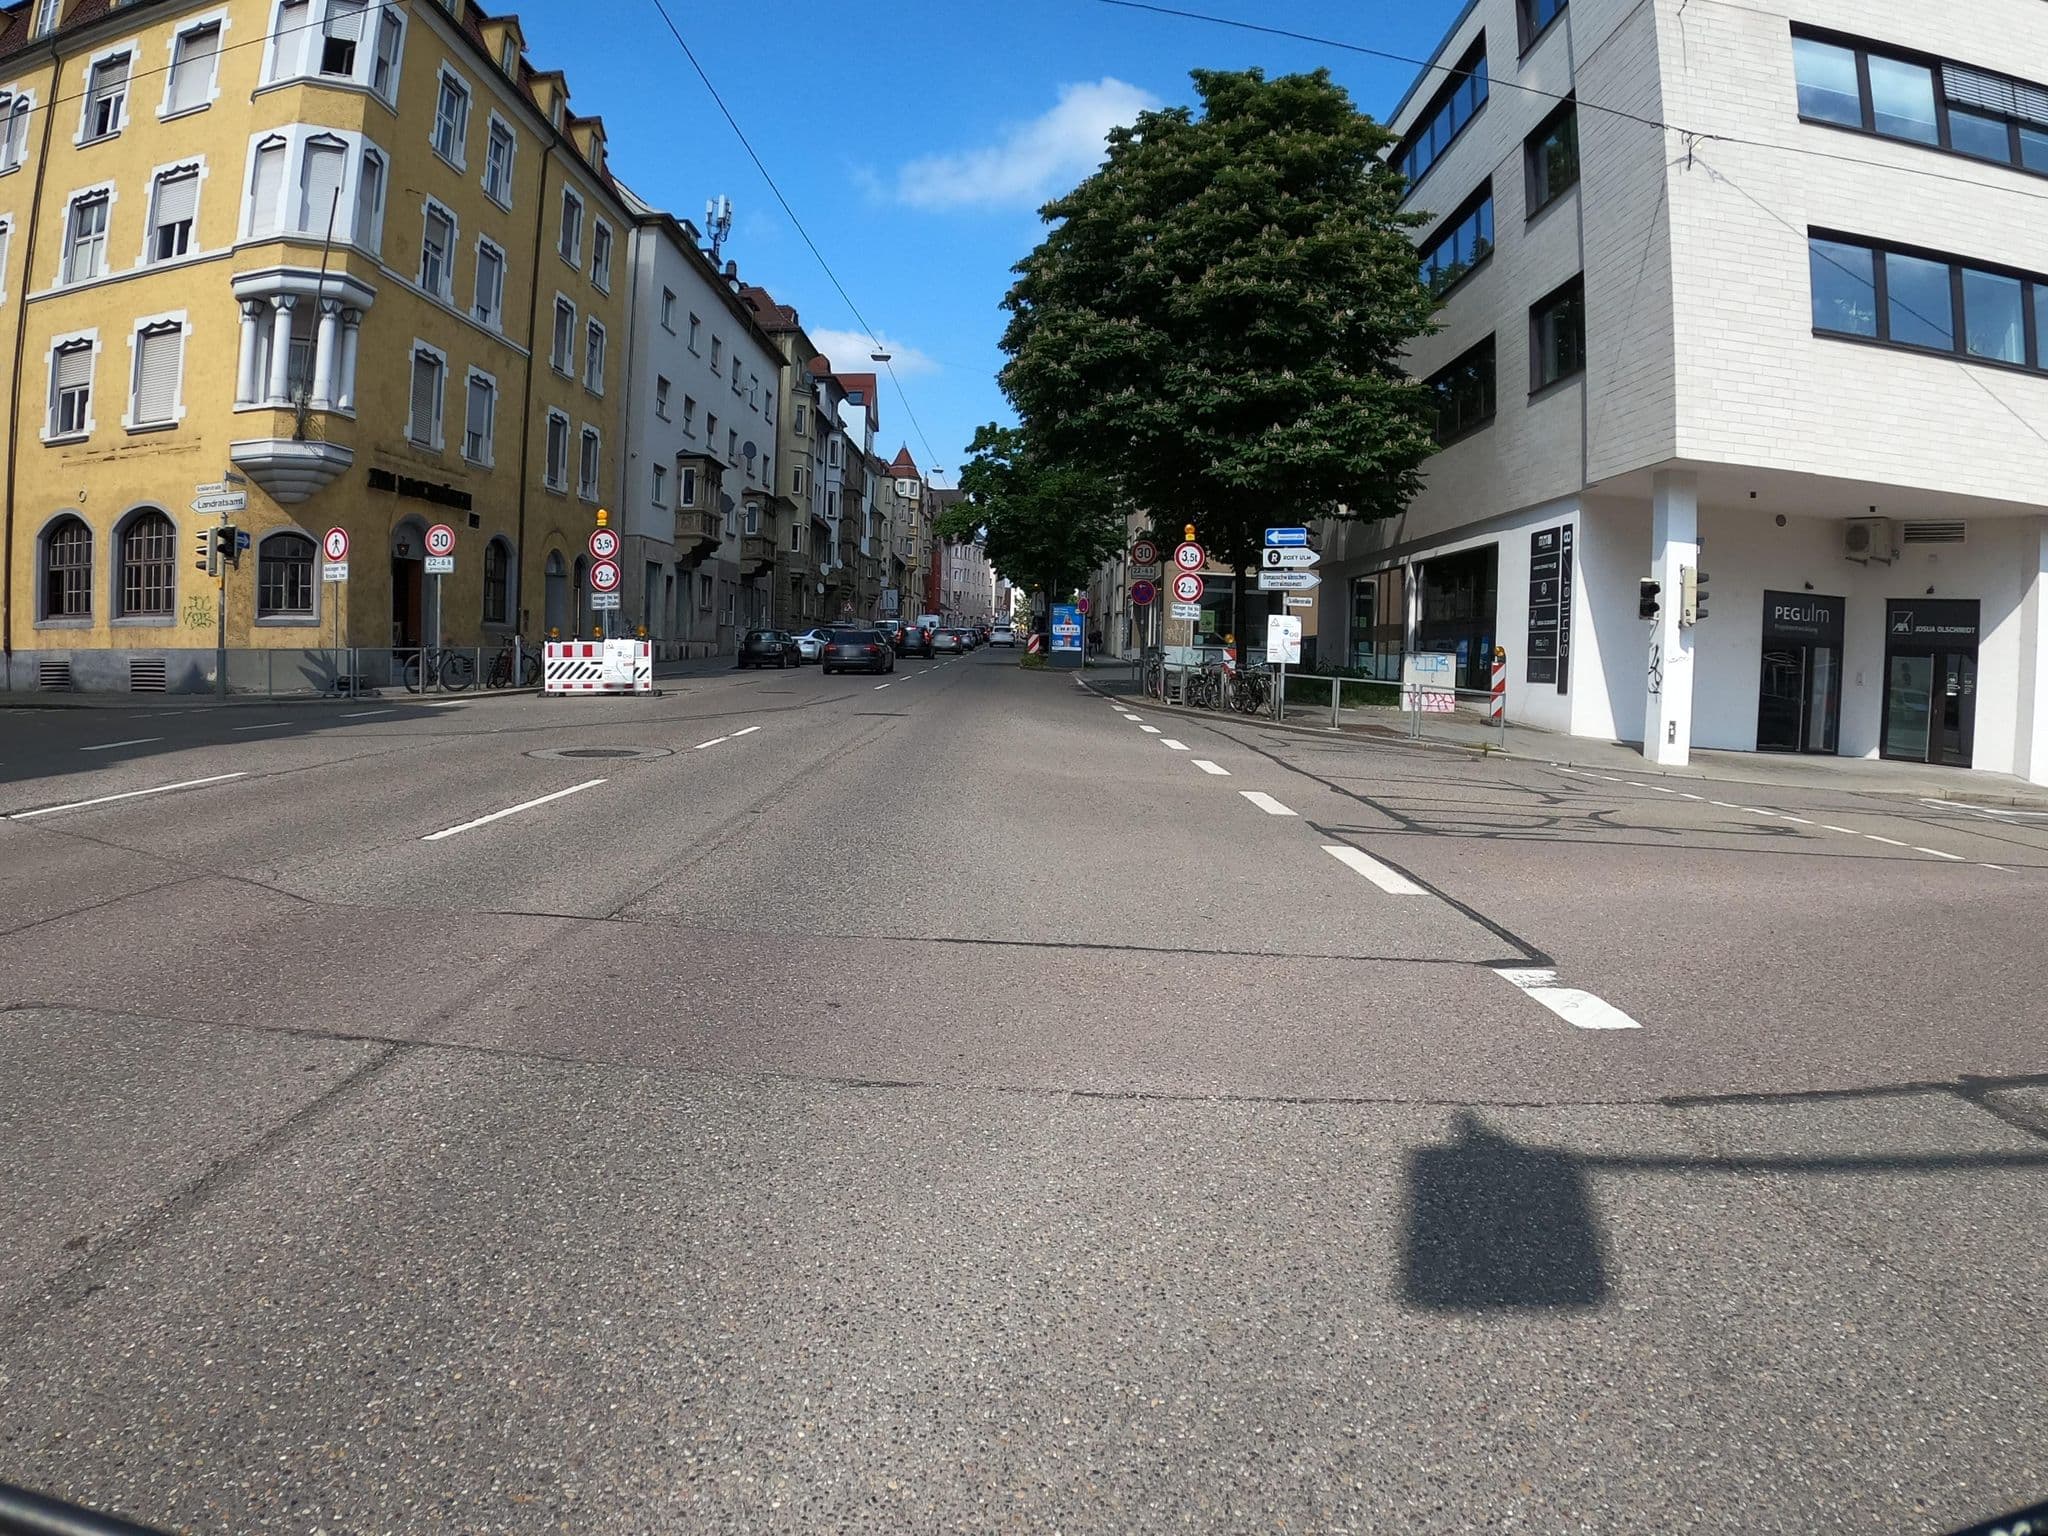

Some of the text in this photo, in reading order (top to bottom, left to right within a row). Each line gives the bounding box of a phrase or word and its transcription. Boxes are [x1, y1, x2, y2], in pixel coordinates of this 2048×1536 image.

[198, 498, 243, 509] Landratsamt
[432, 533, 448, 547] 30
[596, 538, 612, 550] 3,5t
[1137, 547, 1151, 559] 30
[1182, 550, 1198, 563] 3,5t
